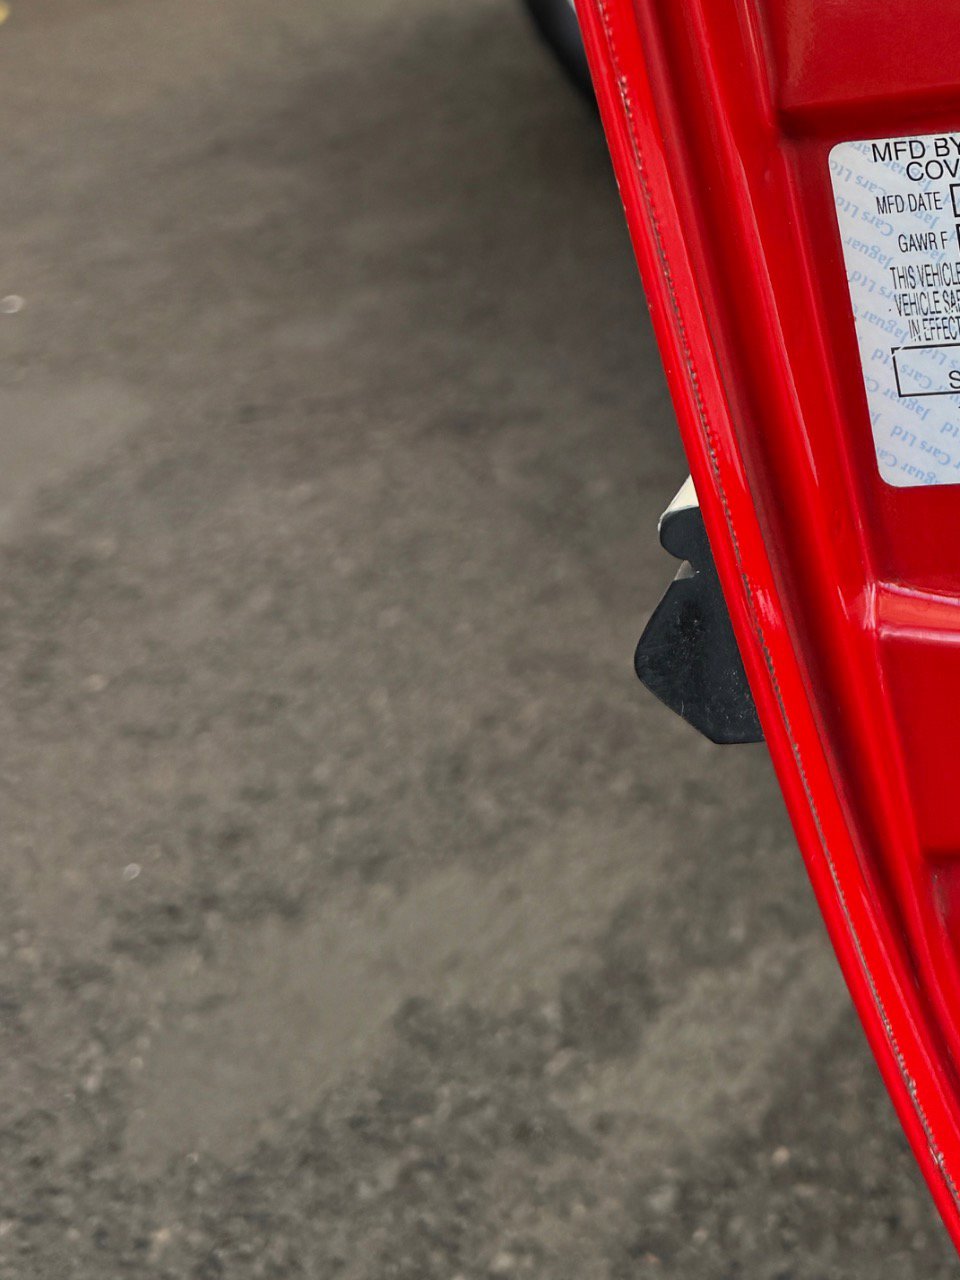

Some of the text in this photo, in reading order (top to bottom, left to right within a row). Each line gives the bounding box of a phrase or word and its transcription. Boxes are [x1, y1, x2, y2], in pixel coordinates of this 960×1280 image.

[871, 140, 926, 163] MFD
[876, 194, 905, 215] MFD
[907, 191, 943, 212] DATE
[898, 232, 938, 253] GAWR
[939, 231, 948, 250] F
[889, 265, 917, 290] THIS
[895, 290, 942, 317] VEHICLE
[908, 319, 921, 342] IN
